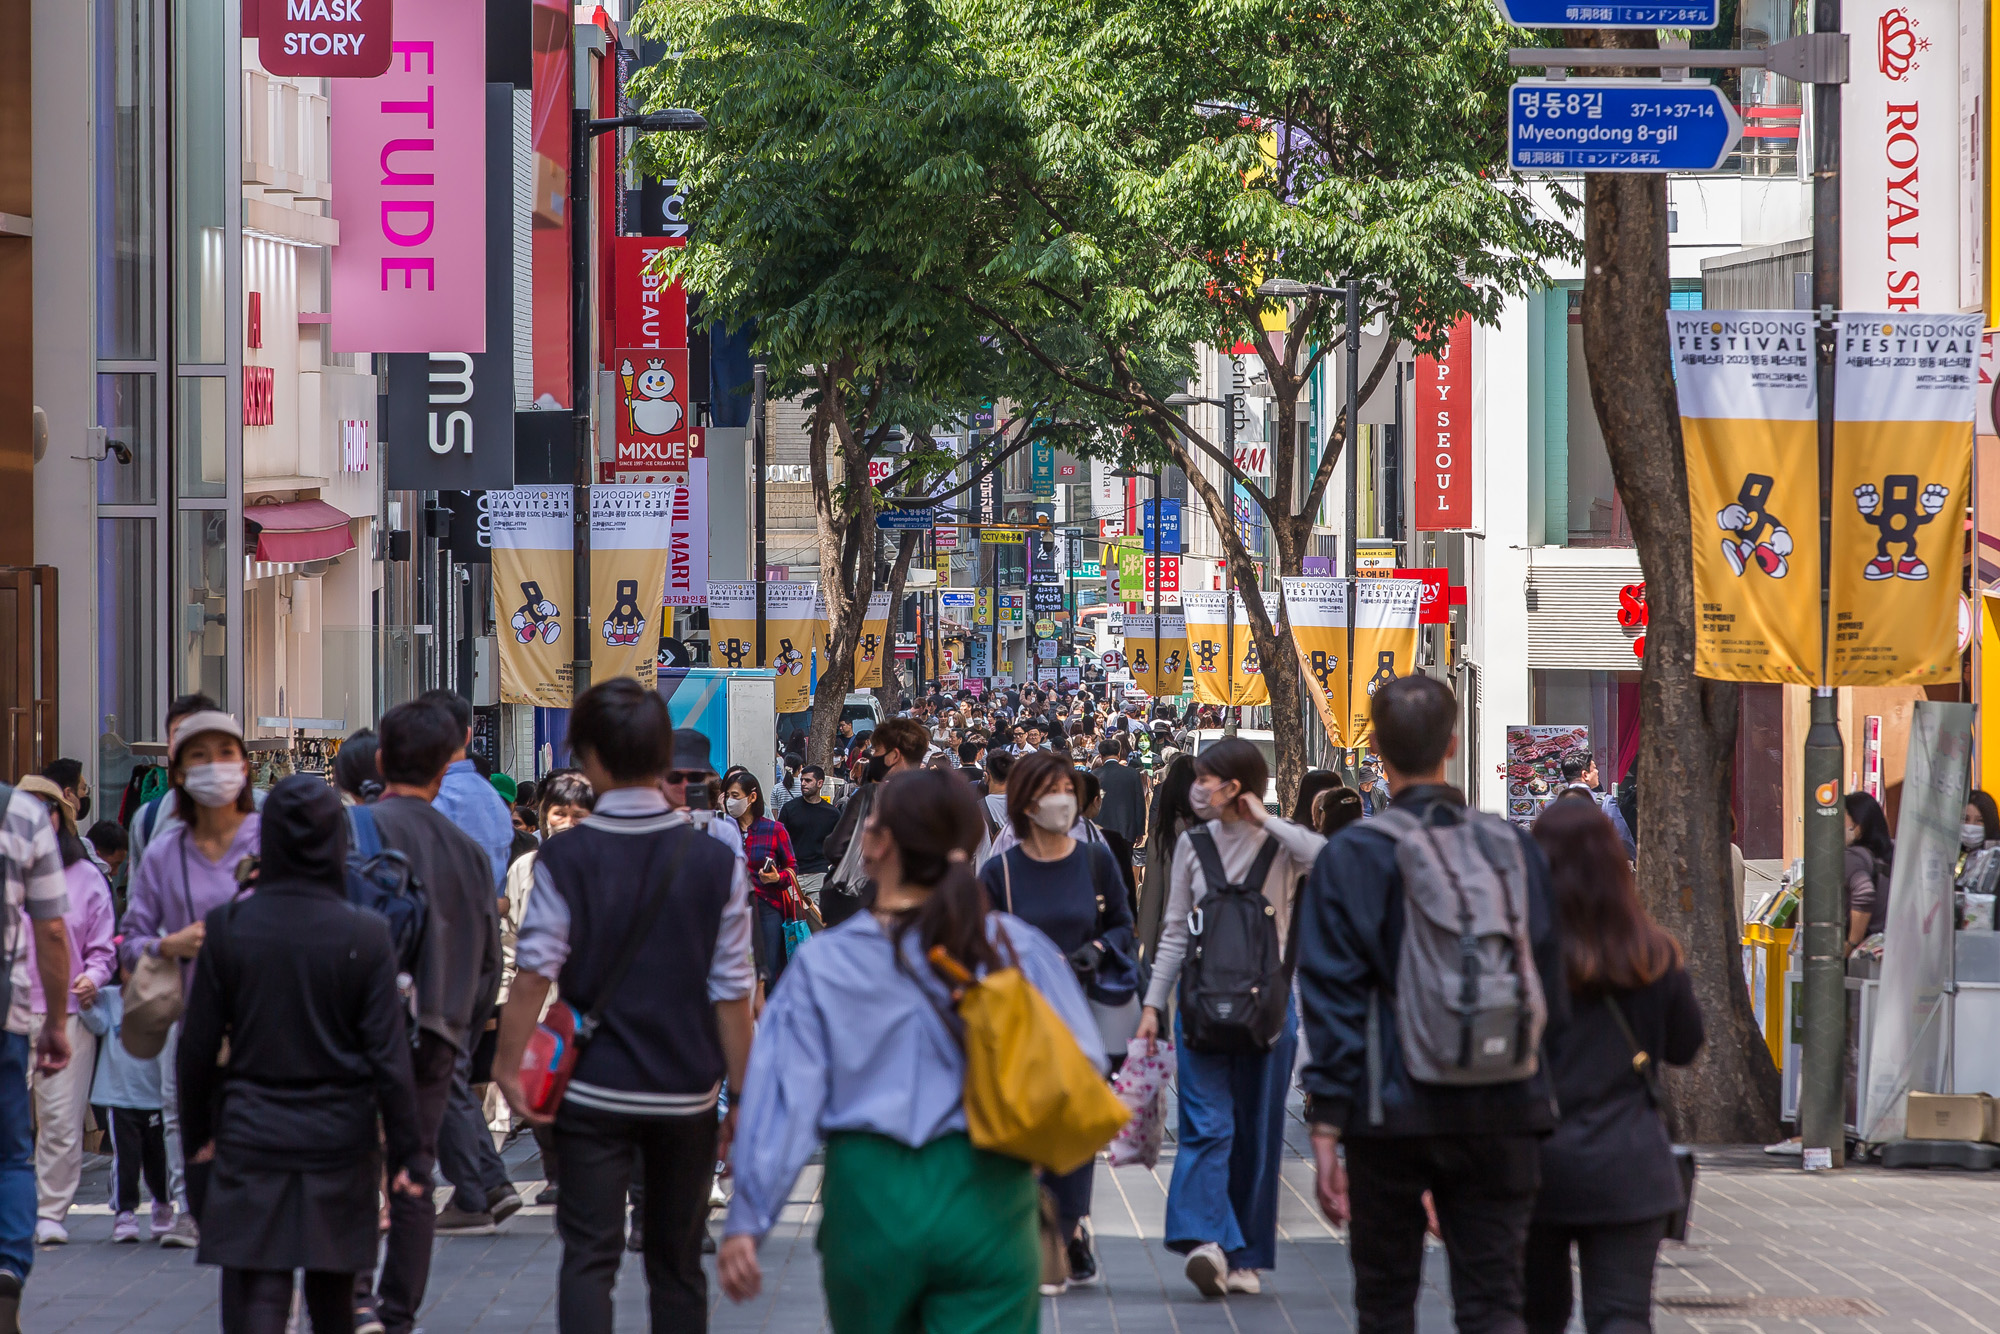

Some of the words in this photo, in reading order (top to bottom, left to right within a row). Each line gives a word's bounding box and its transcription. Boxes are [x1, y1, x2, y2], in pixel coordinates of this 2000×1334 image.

[286, 0, 362, 22] MASK
[1565, 7, 1613, 21] 明洞8街
[283, 32, 365, 56] STORY
[1518, 92, 1603, 119] 명동8길
[1518, 124, 1633, 144] Myeongdong
[1637, 124, 1679, 144] 8-gil
[1518, 151, 1565, 165] 明洞8街
[1577, 151, 1661, 165] ミョンドン8ギル
[380, 40, 434, 292] ETUDE
[1886, 100, 1920, 262] ROYAL
[1679, 337, 1807, 351] FESTIVAL
[1846, 339, 1974, 353] FESTIVAL
[1726, 355, 1750, 366] 2023
[1893, 356, 1917, 368] 2023
[618, 442, 685, 459] MIXUE
[1234, 447, 1266, 473] H&M
[1435, 411, 1452, 511] SEOUL
[1062, 467, 1073, 475] 5G
[1147, 523, 1178, 531] 치병원
[981, 533, 999, 541] CCTV
[671, 533, 690, 592] MART
[1148, 581, 1176, 589] diso
[1286, 588, 1343, 596] FESTIVAL
[663, 595, 707, 604] 과자할인점
[1360, 590, 1418, 598] FESTIVAL
[1103, 652, 1121, 670] 약
